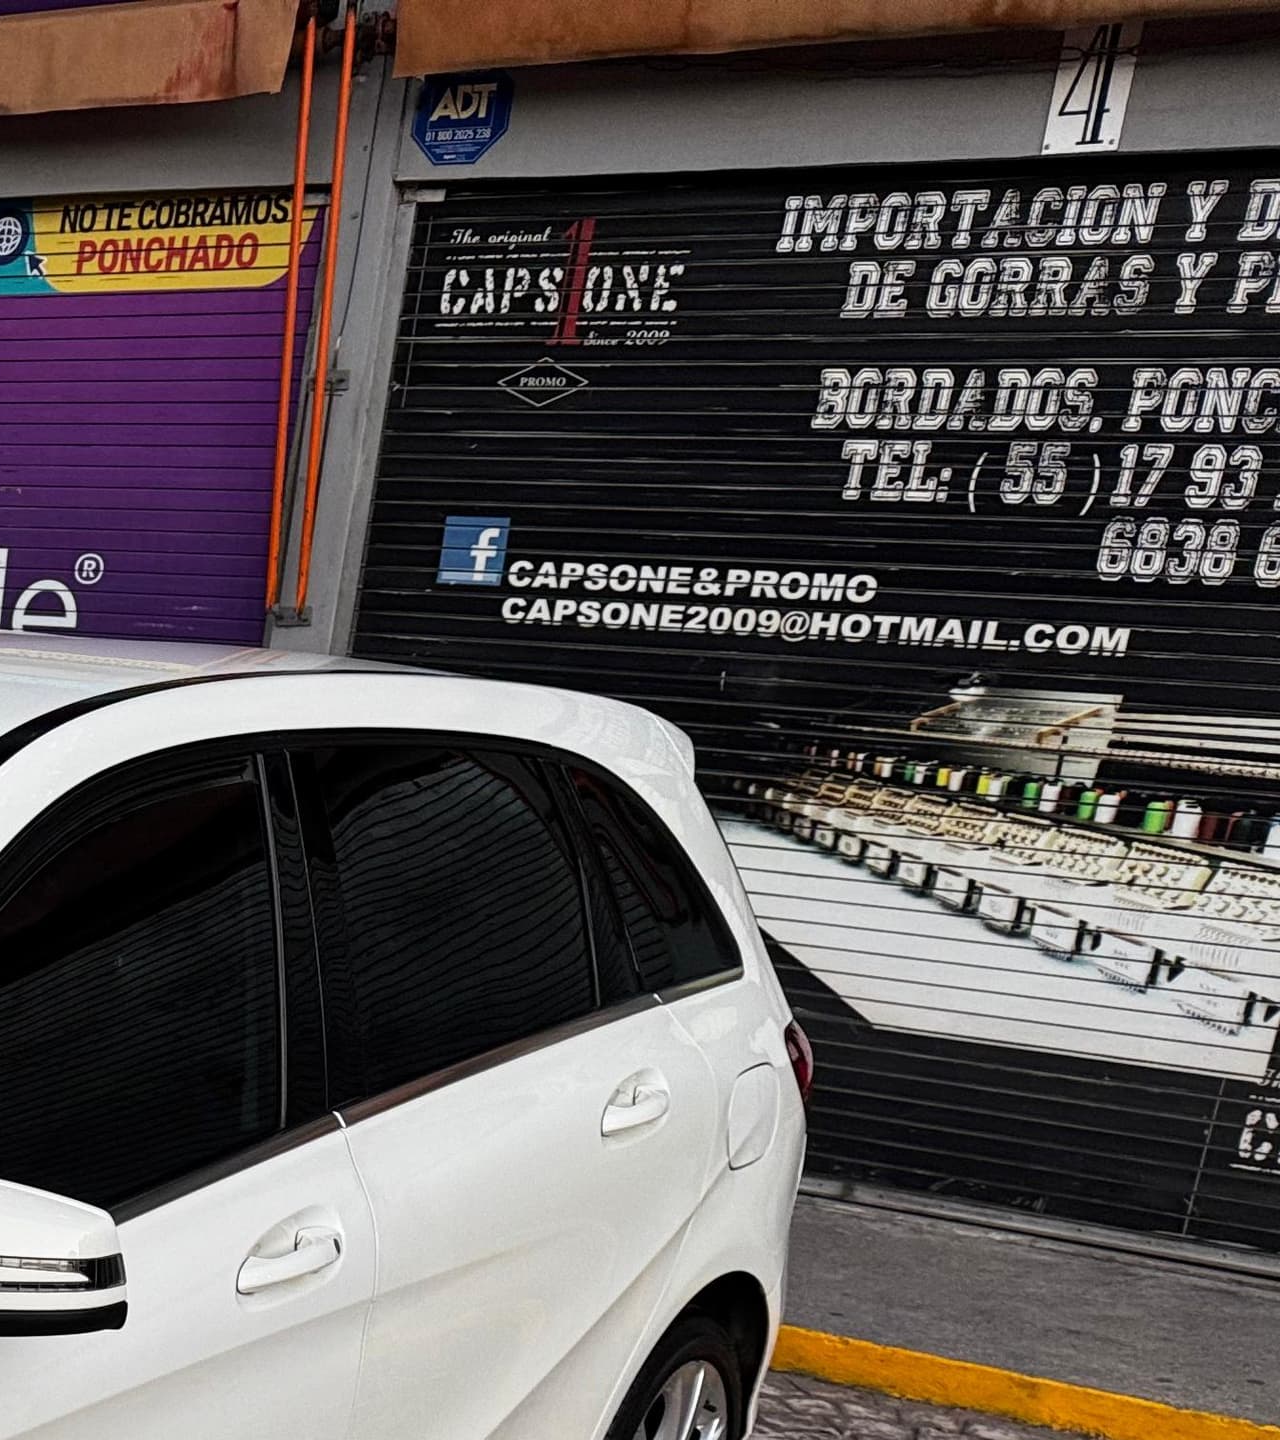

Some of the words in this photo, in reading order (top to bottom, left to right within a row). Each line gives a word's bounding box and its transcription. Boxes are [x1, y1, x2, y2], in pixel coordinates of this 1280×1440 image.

[429, 82, 497, 122] ADT
[1057, 23, 1124, 146] 4
[60, 203, 96, 234] NO
[102, 202, 133, 231] TE
[137, 194, 291, 230] COBRAMOS
[450, 227, 481, 245] The
[488, 226, 553, 250] original
[775, 183, 1167, 252] IMPORTACION
[1185, 180, 1229, 243] Y
[1237, 178, 1280, 241] D
[76, 232, 259, 275] PONCHADO
[840, 260, 916, 319] DE
[925, 254, 1156, 319] GORRAS
[1174, 251, 1219, 314] Y
[519, 376, 567, 388] PROMO
[810, 367, 1104, 433] BORDADOS,
[1121, 366, 1280, 434] PONC
[841, 439, 953, 503] TEL:
[1109, 442, 1175, 508] 17
[1183, 443, 1264, 511] 93
[507, 559, 878, 604] CAPSONE&PROMO
[1096, 516, 1240, 587] 6838
[501, 597, 1132, 658] CAPSONE2009@HOTMAIL.COM
